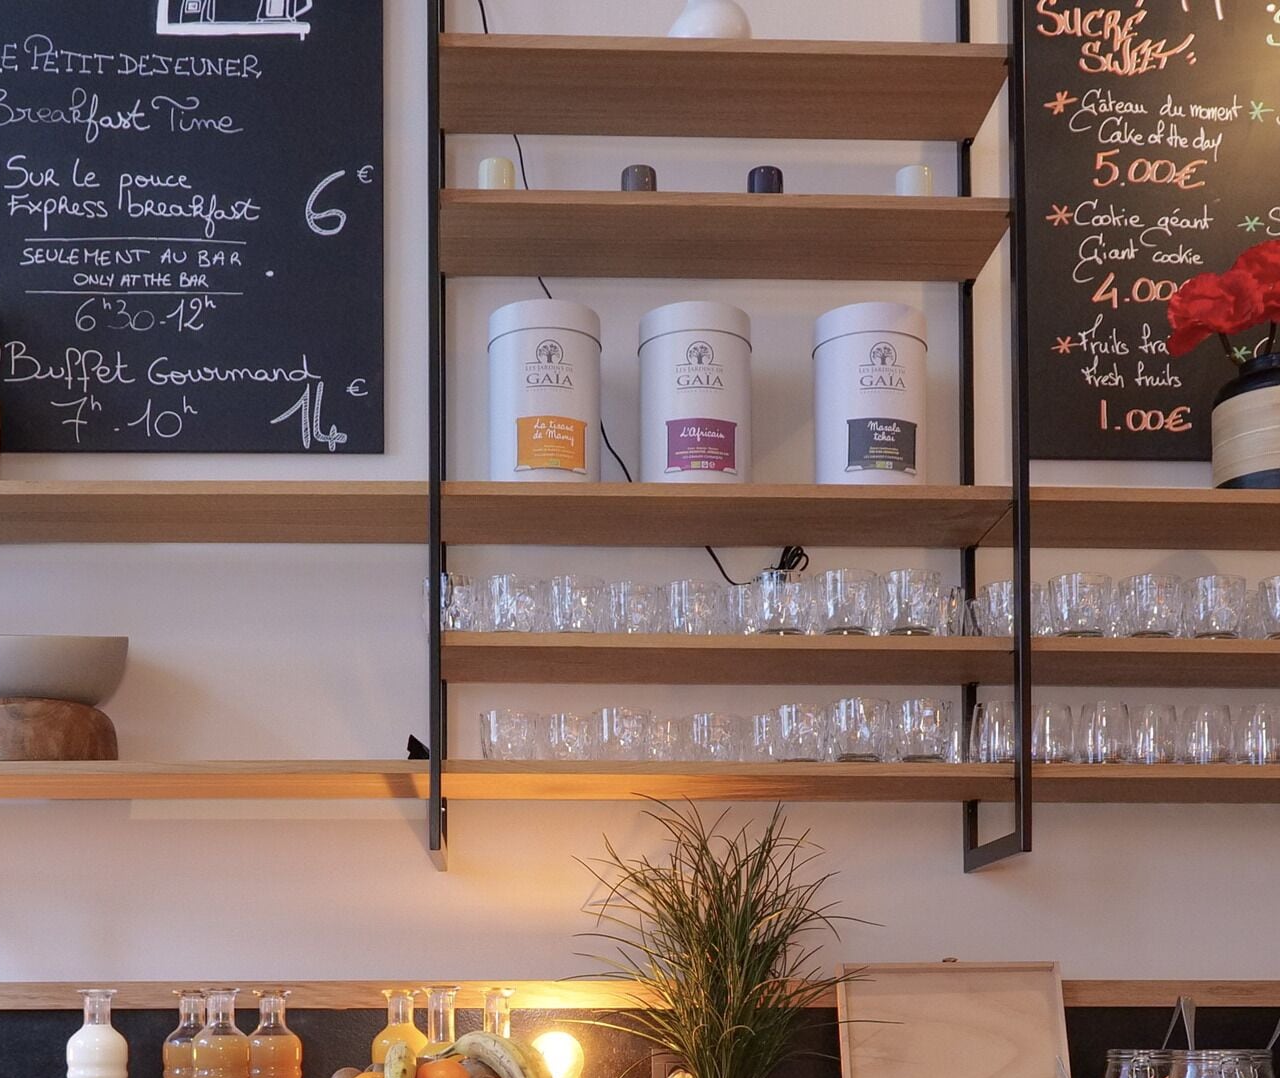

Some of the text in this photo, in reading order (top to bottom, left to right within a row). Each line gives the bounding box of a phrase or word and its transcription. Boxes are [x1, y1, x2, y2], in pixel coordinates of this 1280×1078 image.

[23, 33, 115, 75] PETIT
[150, 94, 245, 134] Time
[1159, 94, 1186, 118] du
[1189, 94, 1243, 122] moment
[1097, 115, 1223, 162] Cake of the day
[1091, 148, 1209, 190] 5.00€
[118, 172, 194, 211] pouce
[127, 189, 262, 239] breakfast
[1073, 198, 1146, 228] Cookie
[19, 247, 243, 268] SEULEMENT AU BAR
[1151, 243, 1205, 266] cookie
[72, 272, 210, 288] ONLY AT THE BAR
[1091, 271, 1192, 310] 4.00
[1078, 313, 1172, 356] Fruits fra
[3, 340, 322, 393] Buffet Gourmand
[1080, 354, 1184, 390] Fresh fruits
[1099, 399, 1194, 433] 1.00€
